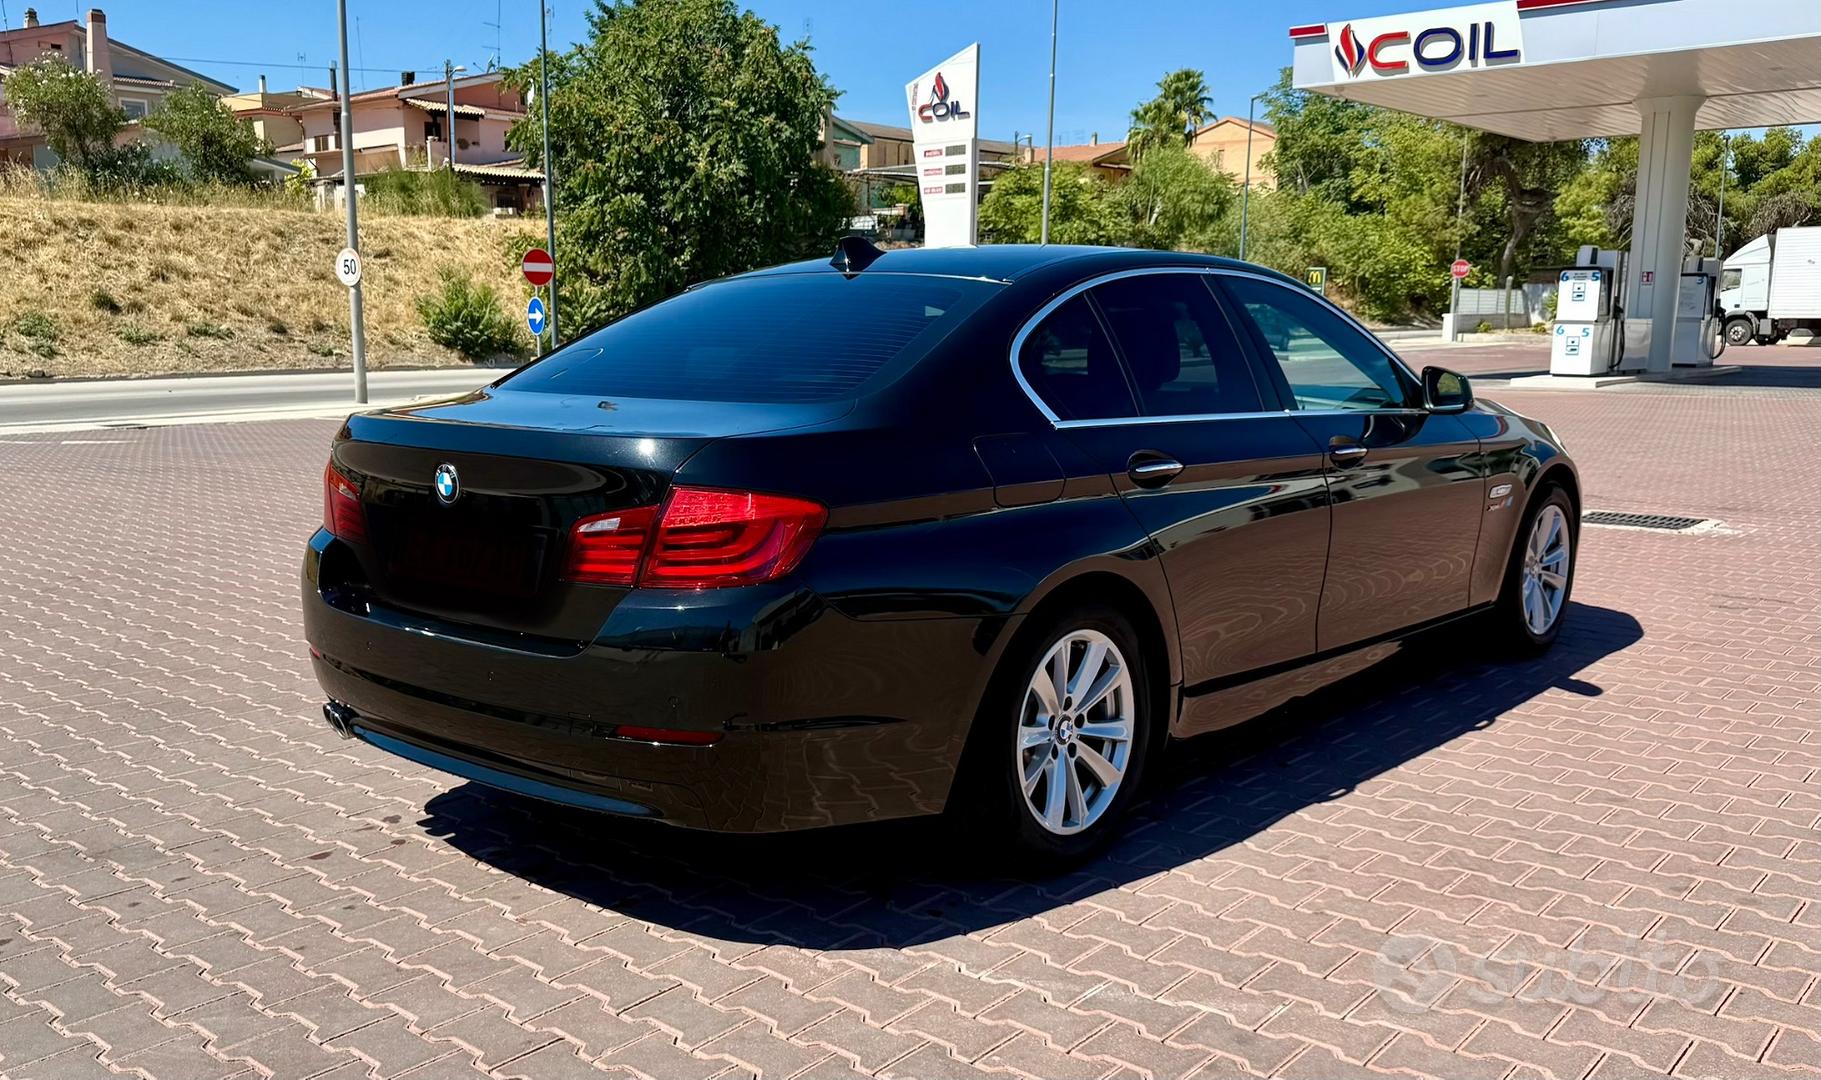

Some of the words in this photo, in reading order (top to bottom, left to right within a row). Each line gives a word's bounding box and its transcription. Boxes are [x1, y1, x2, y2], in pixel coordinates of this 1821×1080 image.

[1368, 21, 1520, 70] COIL
[918, 101, 970, 123] COIL
[343, 258, 357, 275] 50
[1453, 264, 1469, 273] STOP
[1560, 271, 1570, 282] 6
[1591, 271, 1600, 282] 5
[1556, 325, 1565, 335] 6
[1581, 327, 1590, 337] 5
